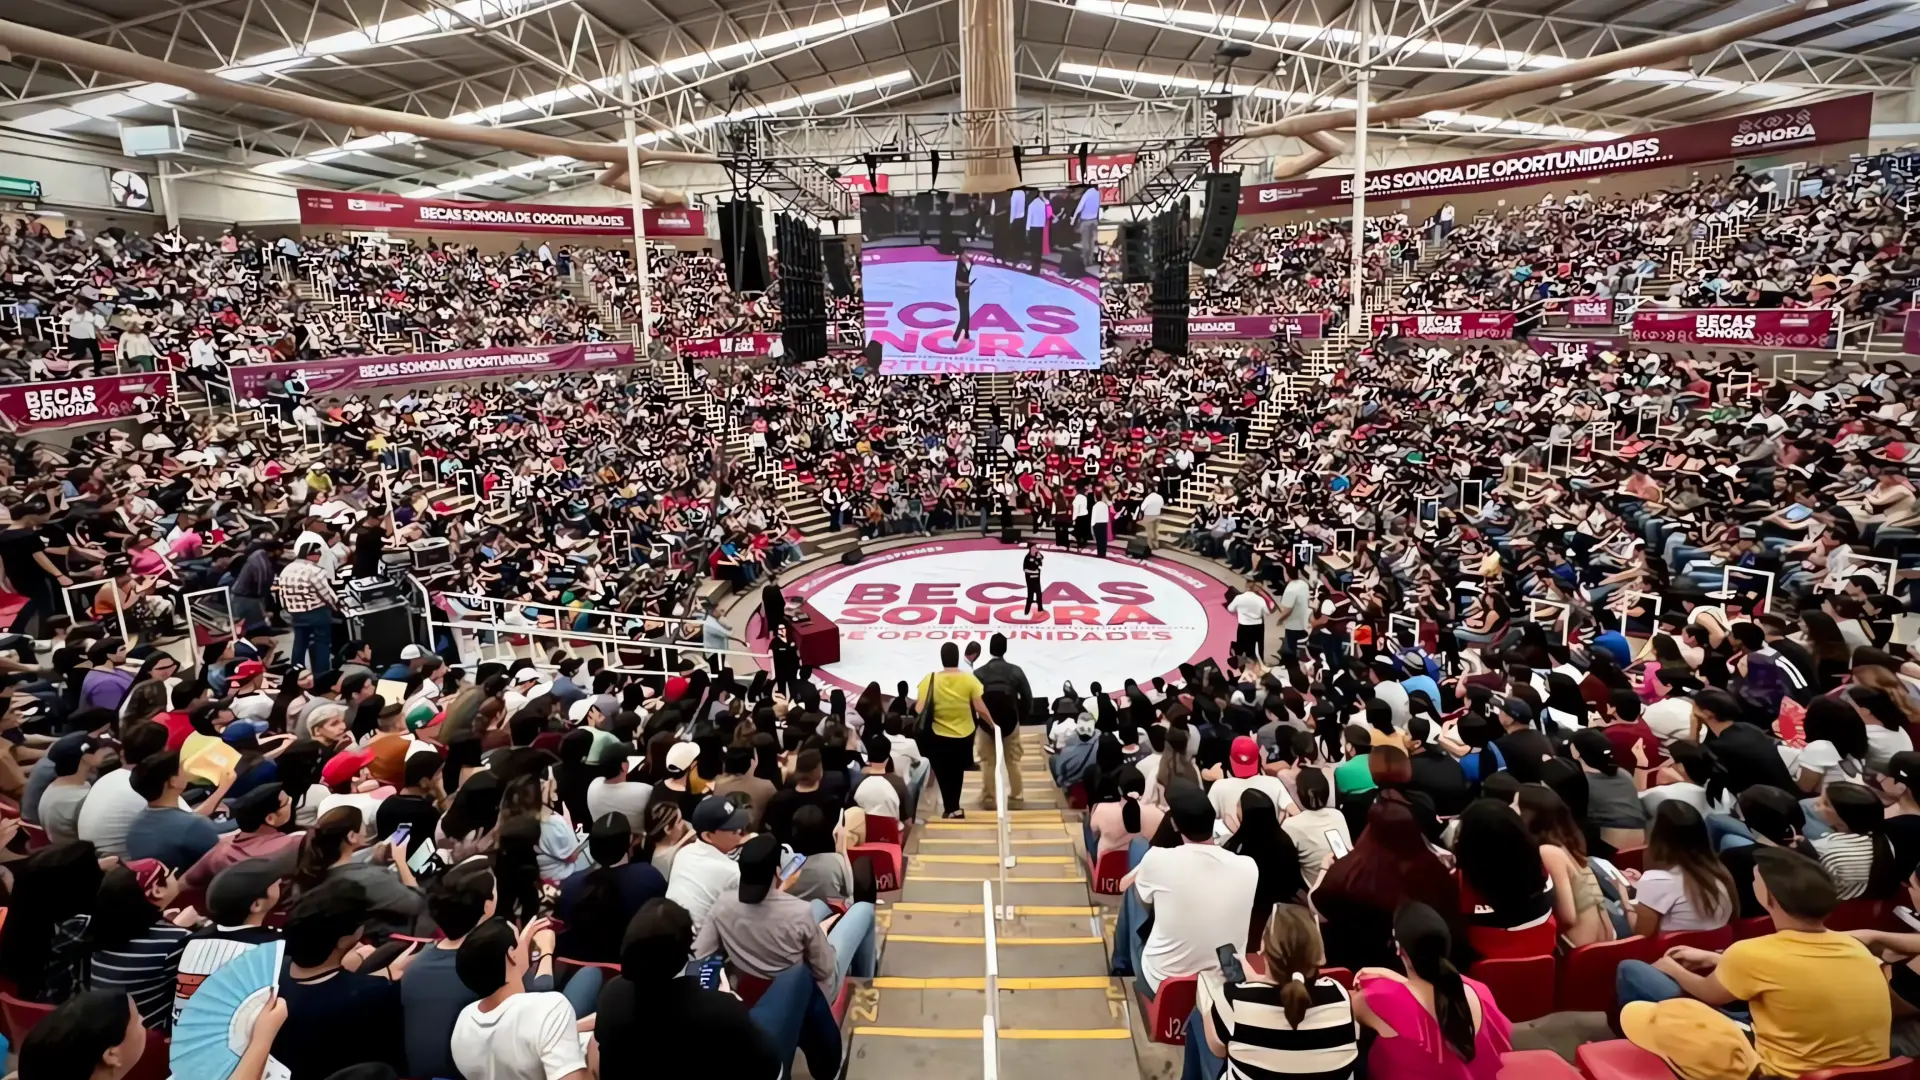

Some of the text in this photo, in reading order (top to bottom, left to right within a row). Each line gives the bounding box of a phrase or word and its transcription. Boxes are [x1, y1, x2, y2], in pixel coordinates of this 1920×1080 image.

[1731, 123, 1815, 147] SONORA
[1341, 175, 1391, 194] BCAS
[1393, 166, 1464, 188] SONORA
[1465, 162, 1490, 180] DE
[1492, 138, 1659, 177] OPORTUNIDADES
[420, 206, 624, 226] BECAS SONORA DE OPORTUNIDADES
[1696, 314, 1756, 329] BECAS
[1696, 327, 1754, 339] SONORA
[360, 352, 550, 377] BECAS SONORA DE OPORTUNIDADES
[25, 385, 96, 409] BECAS
[30, 402, 98, 421] SONORA
[844, 581, 1155, 605] BECAS
[837, 604, 1167, 626] SONORA
[877, 630, 1173, 642] OPORTUNIDADES
